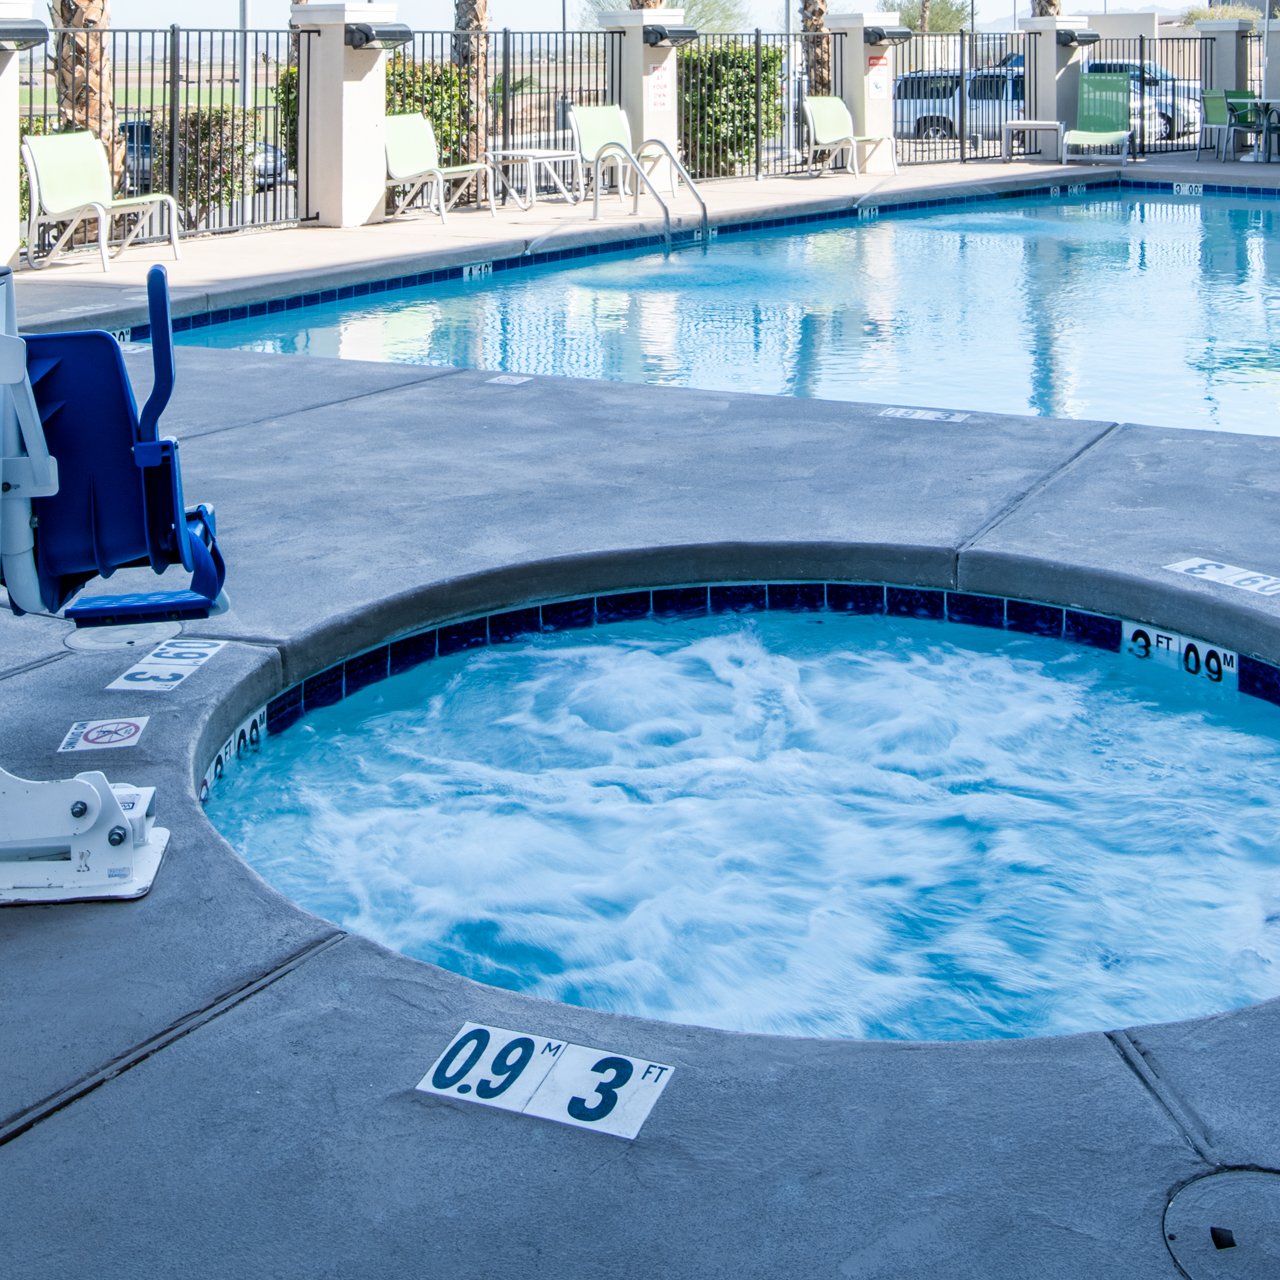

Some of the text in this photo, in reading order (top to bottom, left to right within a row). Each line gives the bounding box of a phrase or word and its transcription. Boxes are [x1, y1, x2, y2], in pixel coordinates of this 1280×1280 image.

[1184, 562, 1226, 575] 3
[151, 641, 221, 660] 0.9
[1127, 628, 1152, 659] 3
[1156, 633, 1173, 651] FT
[1222, 652, 1235, 669] M
[123, 671, 185, 683] 3
[431, 1028, 669, 1123] 0.9 M 3 FT
